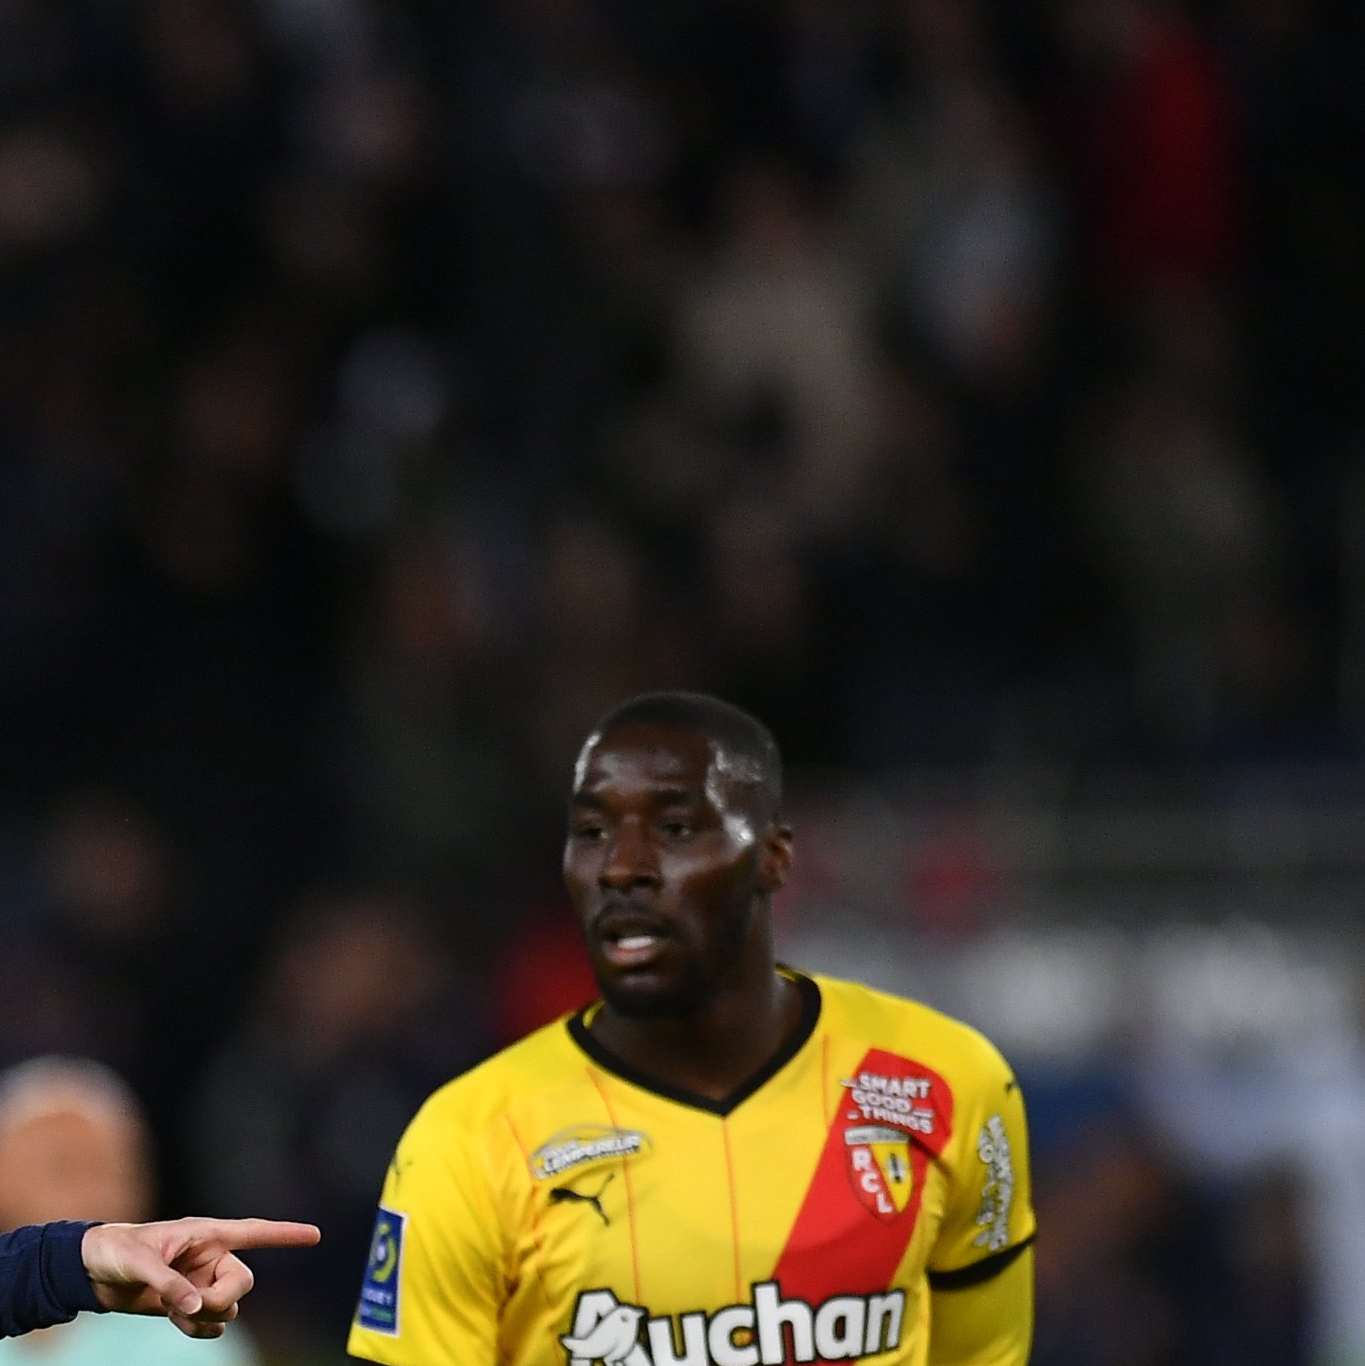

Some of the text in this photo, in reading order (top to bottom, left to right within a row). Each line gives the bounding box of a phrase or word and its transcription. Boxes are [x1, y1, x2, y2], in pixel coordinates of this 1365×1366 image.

[859, 1072, 931, 1099] SMART
[851, 1089, 912, 1113] GOOD
[858, 1104, 934, 1134] THINGS
